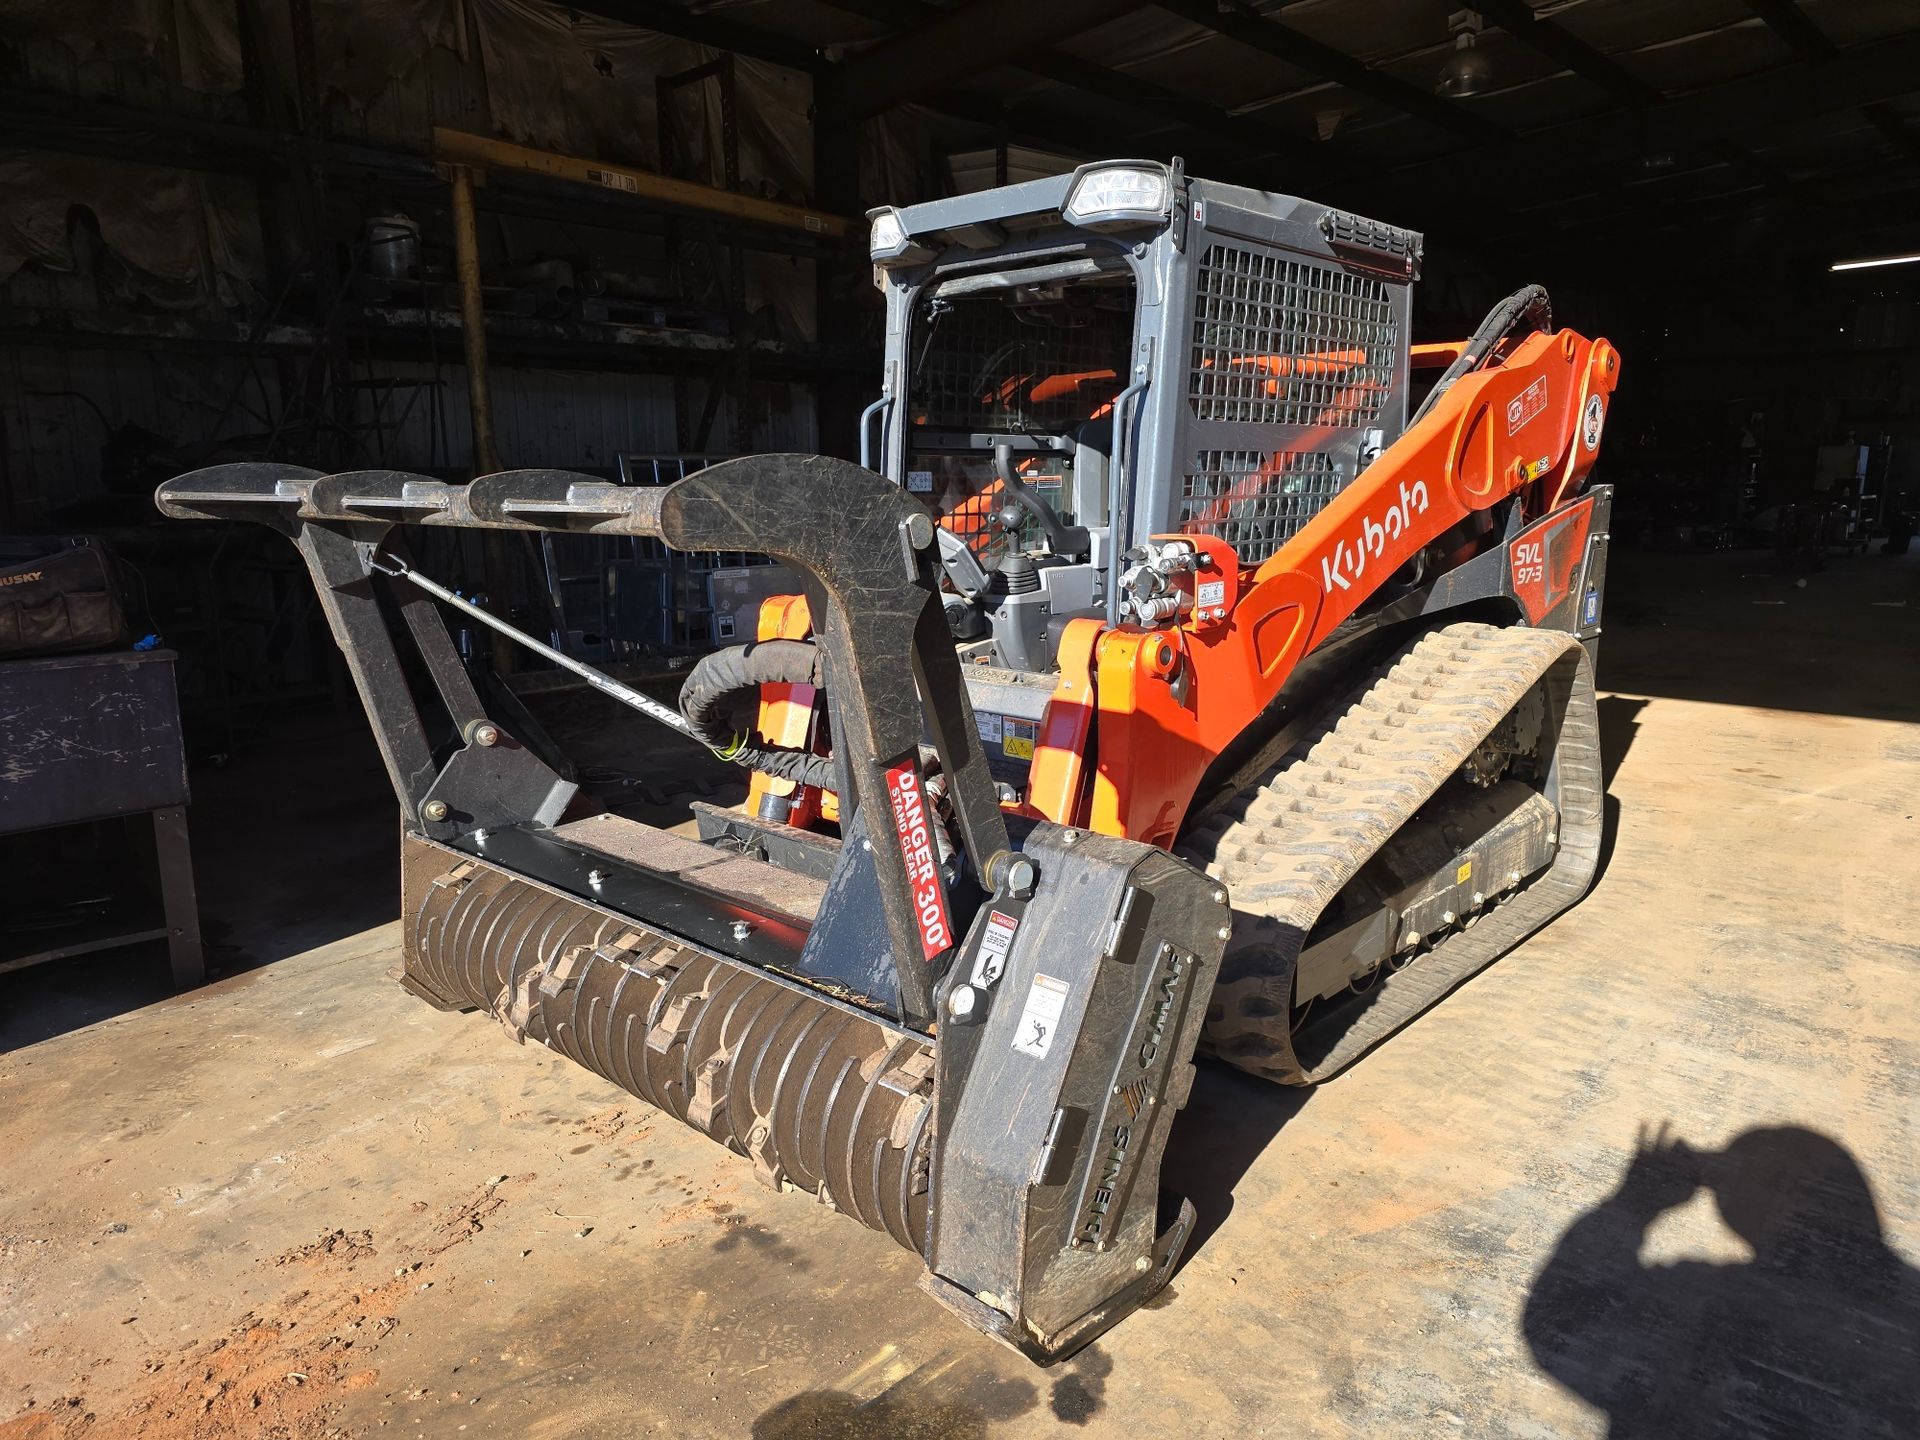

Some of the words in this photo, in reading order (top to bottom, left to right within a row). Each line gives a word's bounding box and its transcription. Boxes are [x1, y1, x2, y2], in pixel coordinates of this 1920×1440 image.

[1321, 480, 1429, 594] Kubota
[1514, 543, 1543, 566] SVL
[1516, 566, 1543, 585] 97-3
[891, 786, 908, 833] STAND
[902, 837, 917, 882] CLEAR
[898, 769, 934, 886] DANGER
[917, 885, 948, 949] 300'
[1080, 1125, 1131, 1247] DENIS
[1138, 952, 1183, 1070] CIMAF
